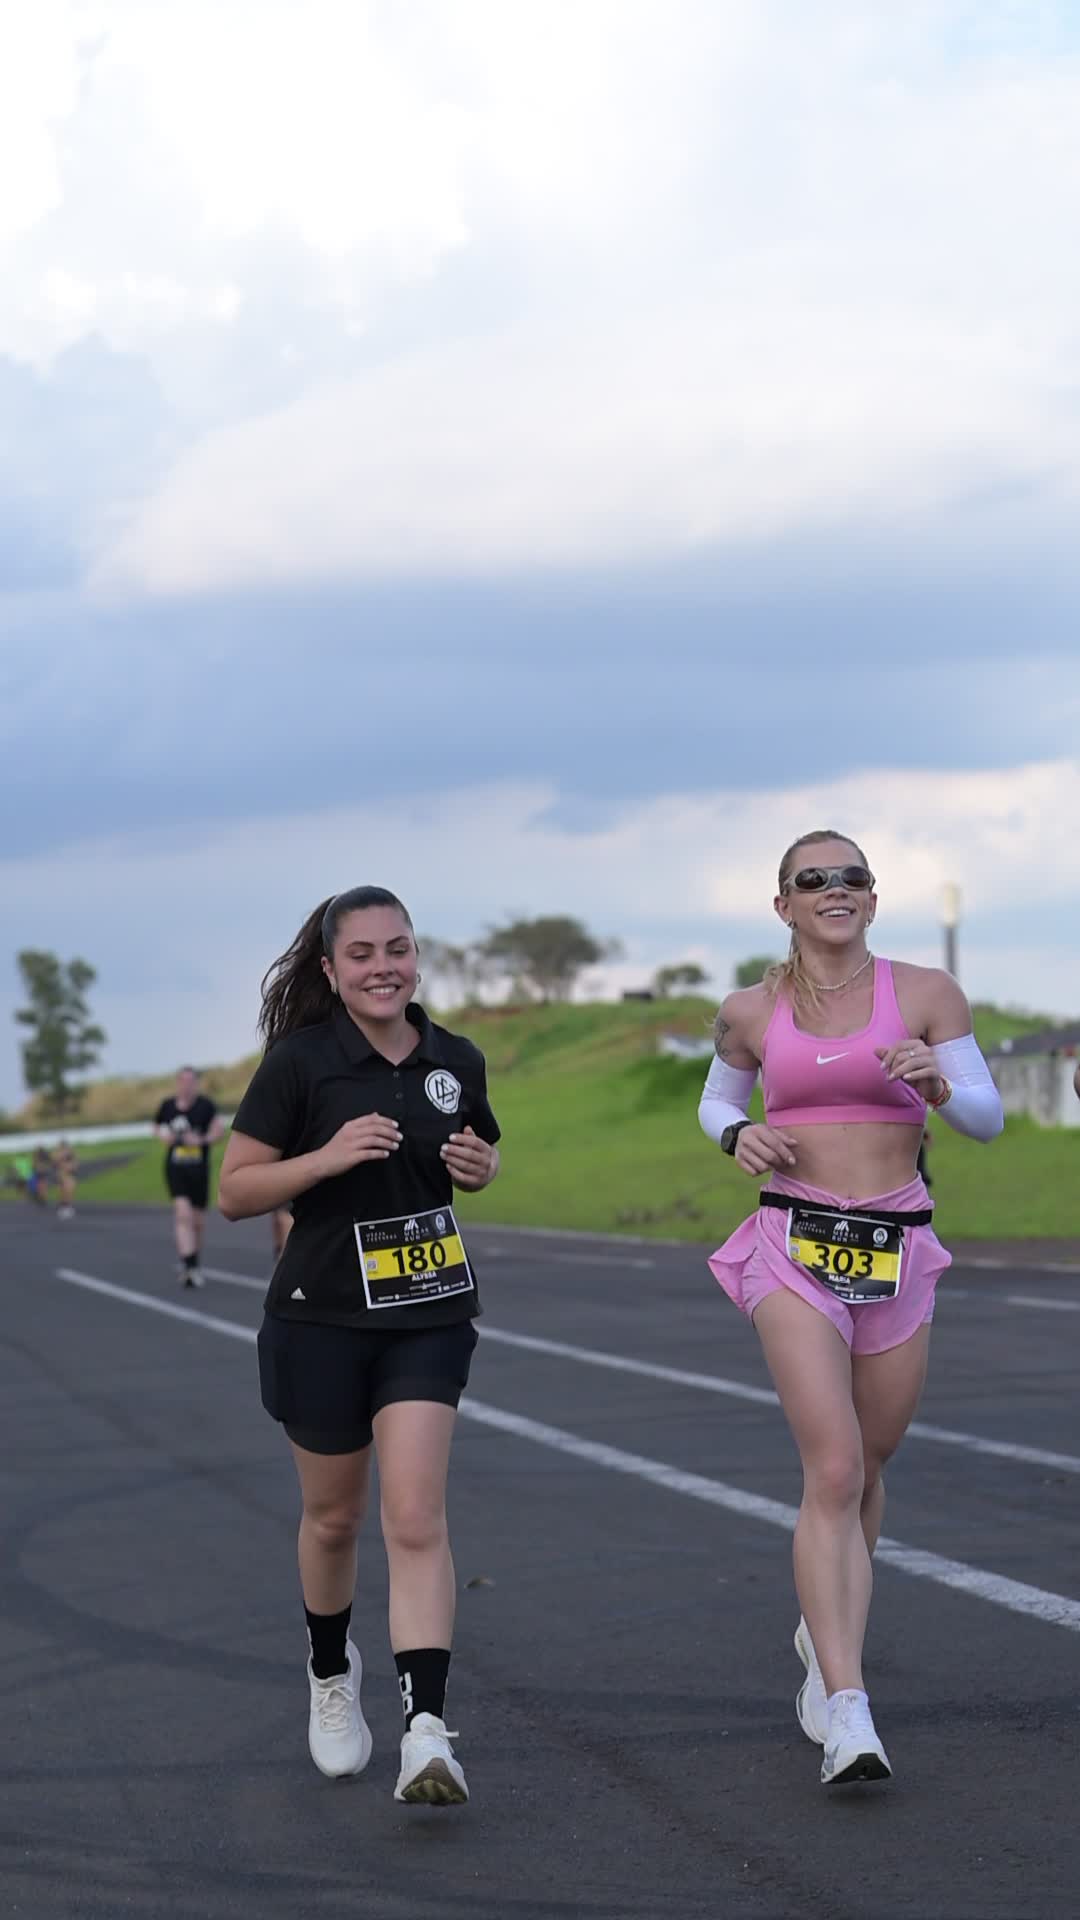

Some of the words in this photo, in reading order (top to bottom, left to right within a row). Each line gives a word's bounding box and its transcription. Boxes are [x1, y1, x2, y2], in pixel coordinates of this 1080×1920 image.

[392, 1241, 447, 1274] 180
[812, 1244, 874, 1277] 303
[411, 1271, 437, 1281] ALYSSA
[828, 1274, 851, 1283] MARIA
